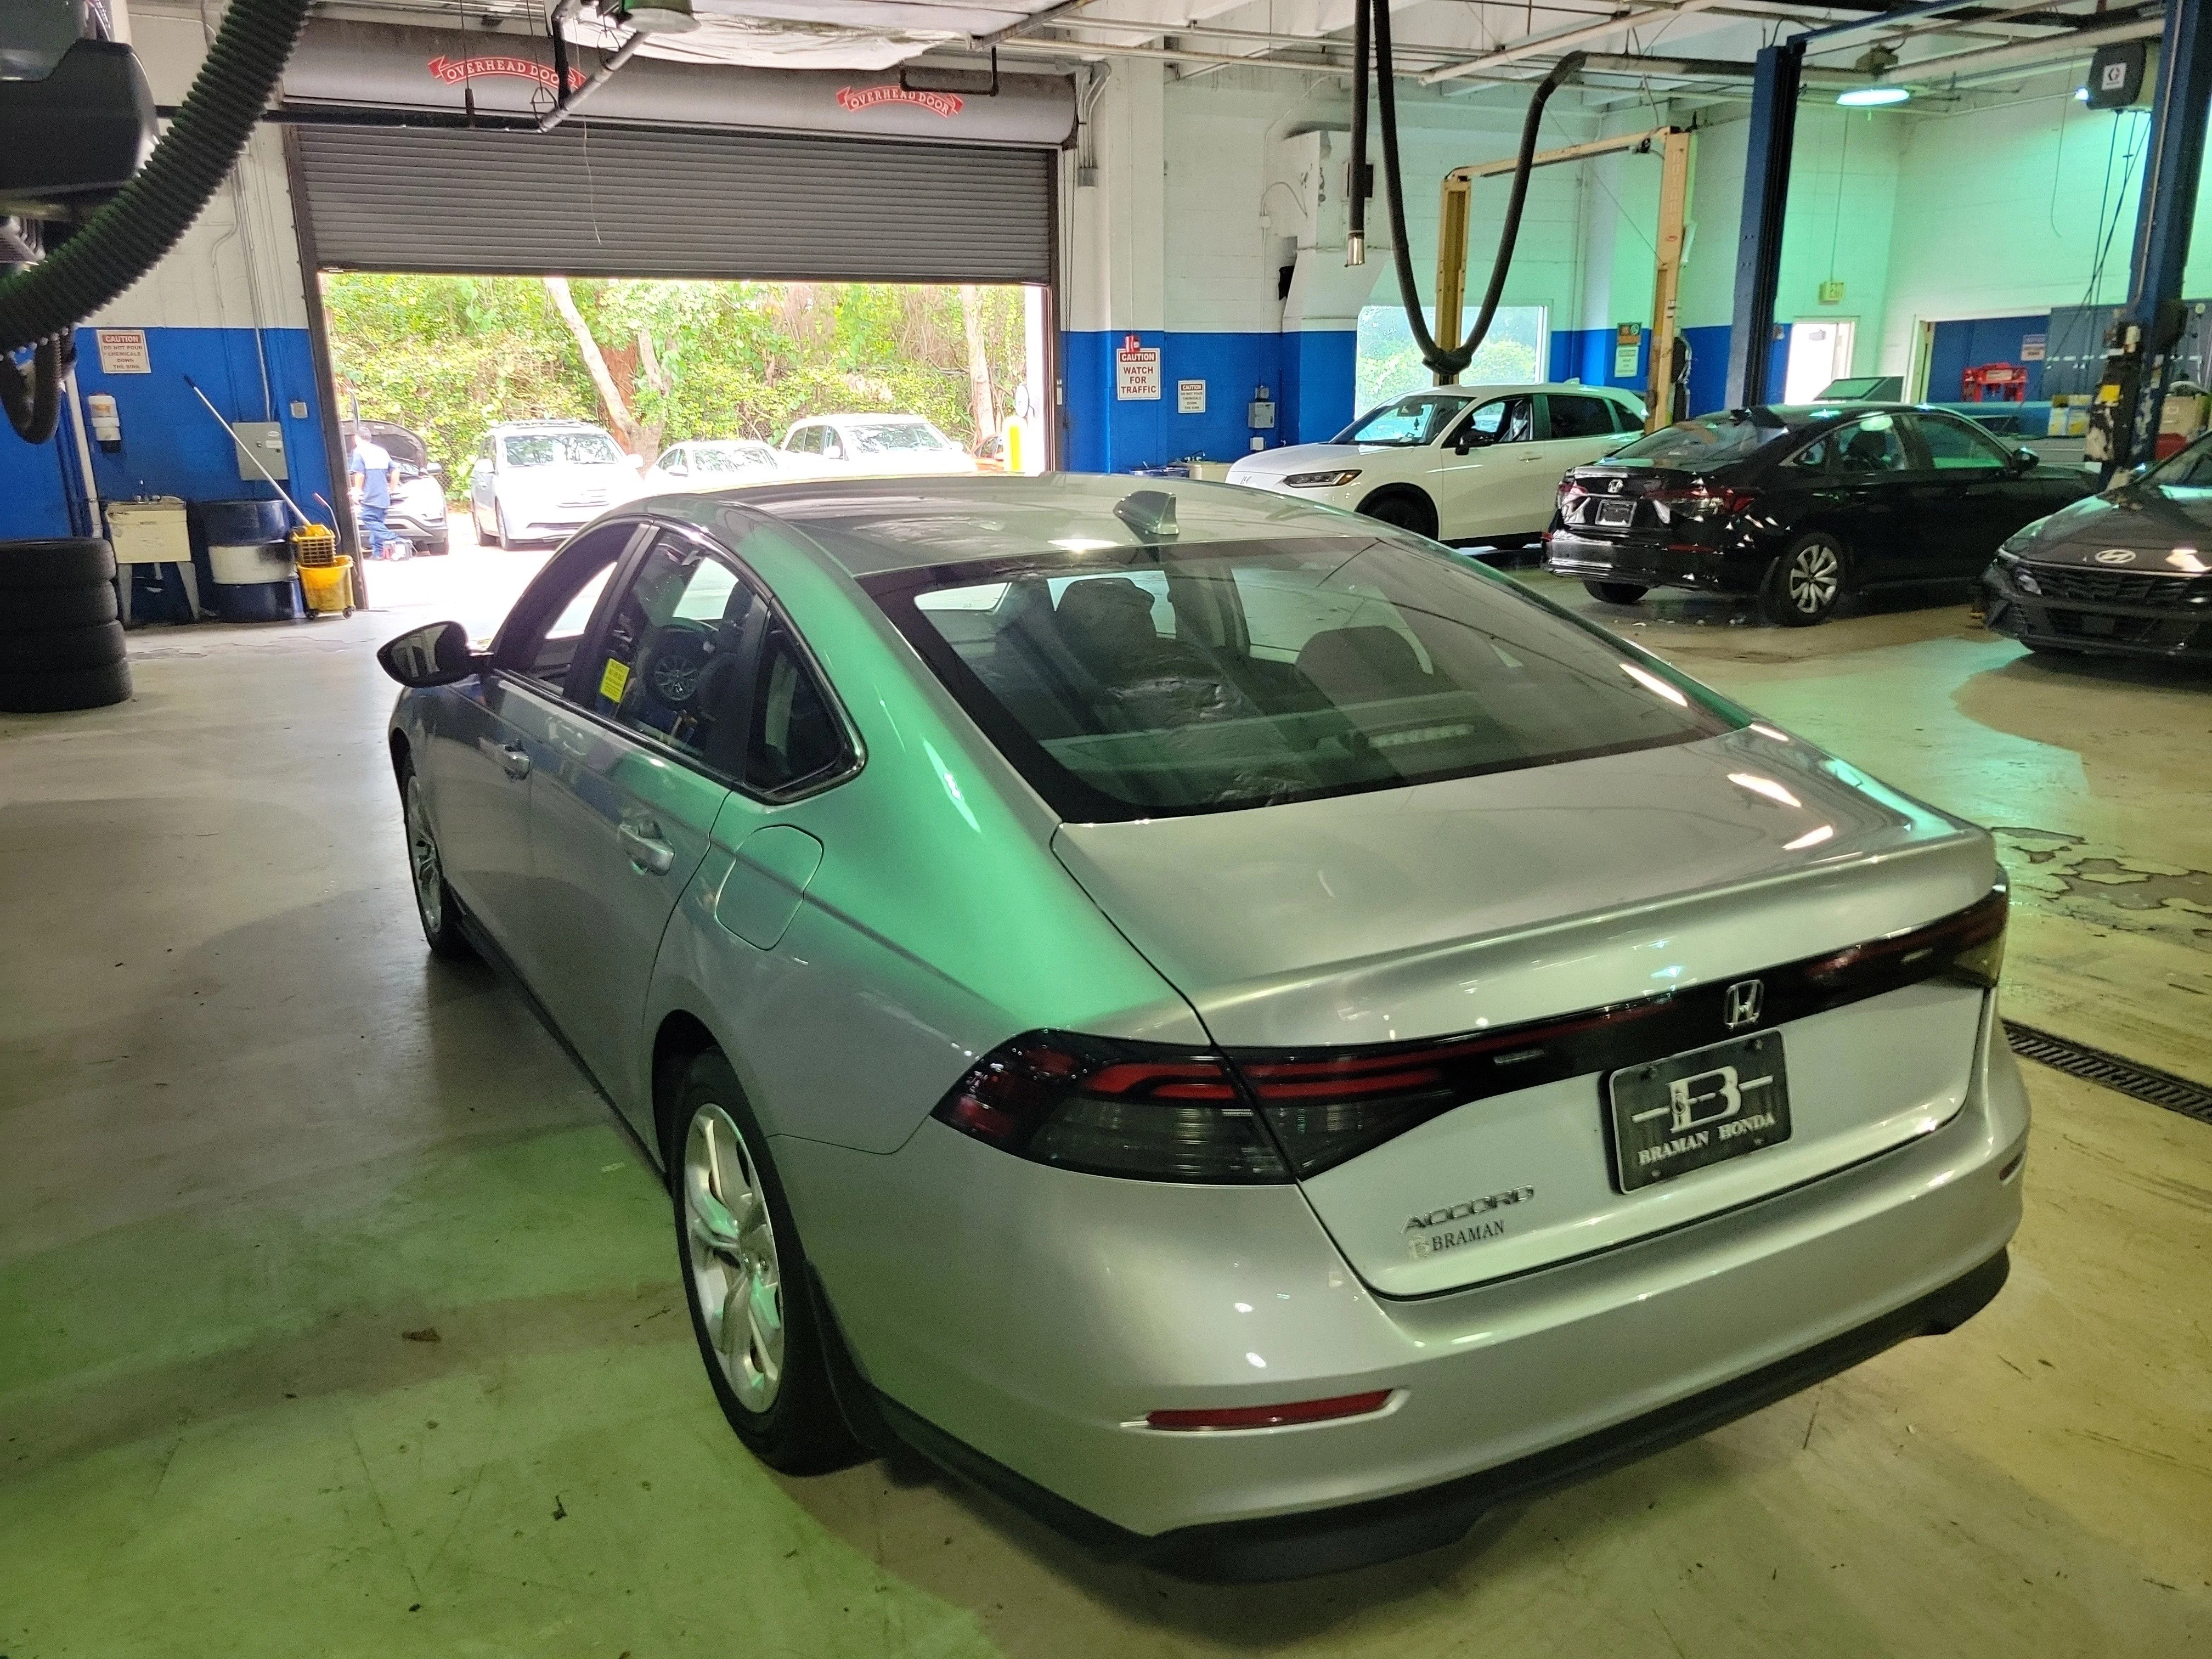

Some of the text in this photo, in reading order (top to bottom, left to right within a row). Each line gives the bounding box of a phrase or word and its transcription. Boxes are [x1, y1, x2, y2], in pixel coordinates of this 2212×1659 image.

[447, 60, 560, 83] OVERHEAD DOO
[850, 88, 949, 115] OVERHEAD DOOR
[1121, 353, 1154, 362] CAUTION
[1123, 366, 1153, 374] WATCH
[1130, 376, 1147, 384] FOR
[1121, 385, 1156, 394] TRAFFIC
[1638, 1113, 1776, 1166] BRAMAN HONDA
[1400, 1184, 1534, 1234] ACCORD
[1431, 1218, 1505, 1251] BRAMAN
